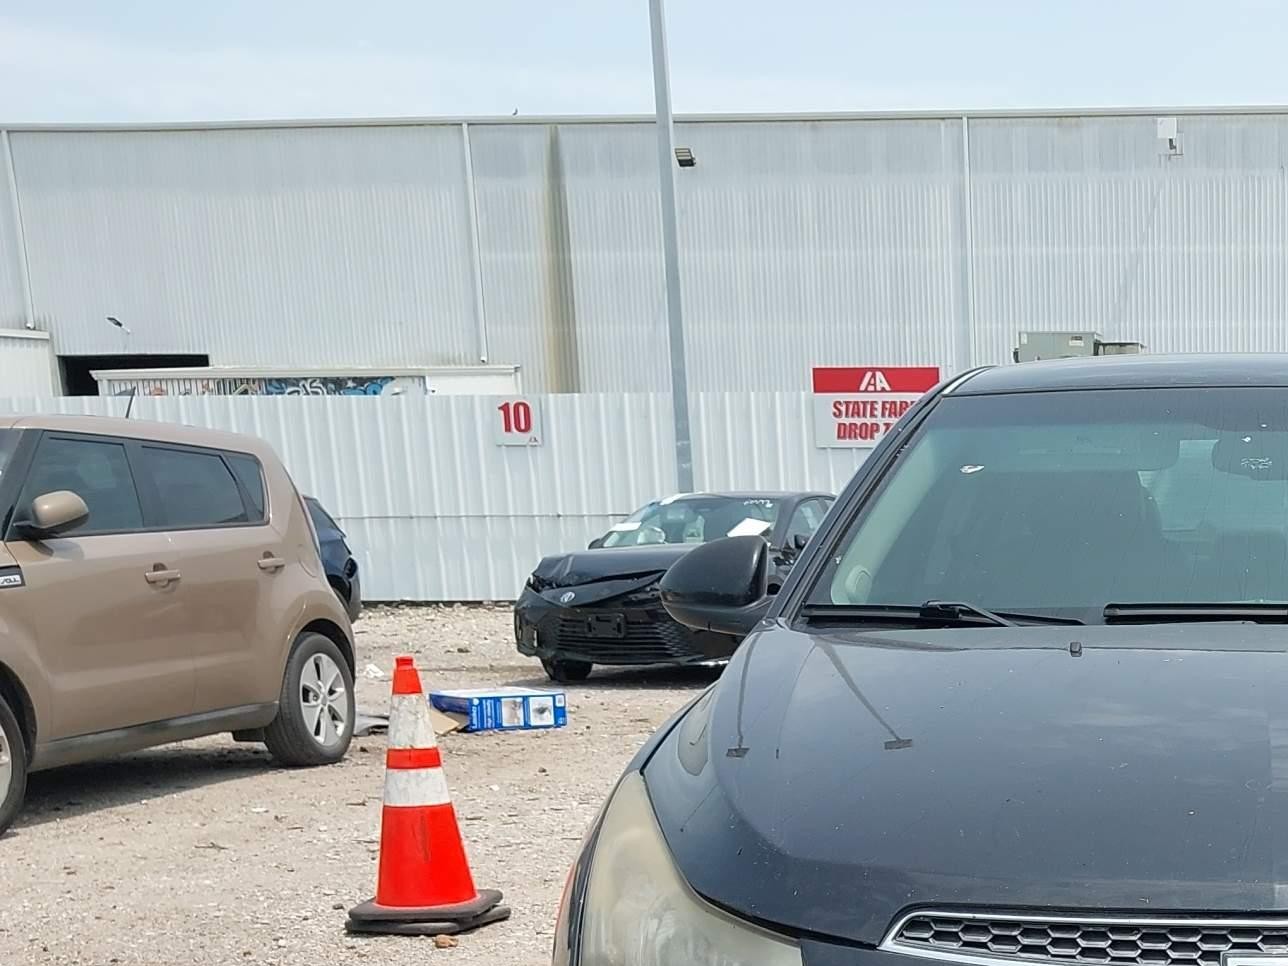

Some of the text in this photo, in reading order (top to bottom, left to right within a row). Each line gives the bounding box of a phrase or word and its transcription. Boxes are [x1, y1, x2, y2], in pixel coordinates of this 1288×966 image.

[497, 402, 531, 432] 10
[832, 400, 878, 418] STATE
[836, 422, 880, 440] DROP
